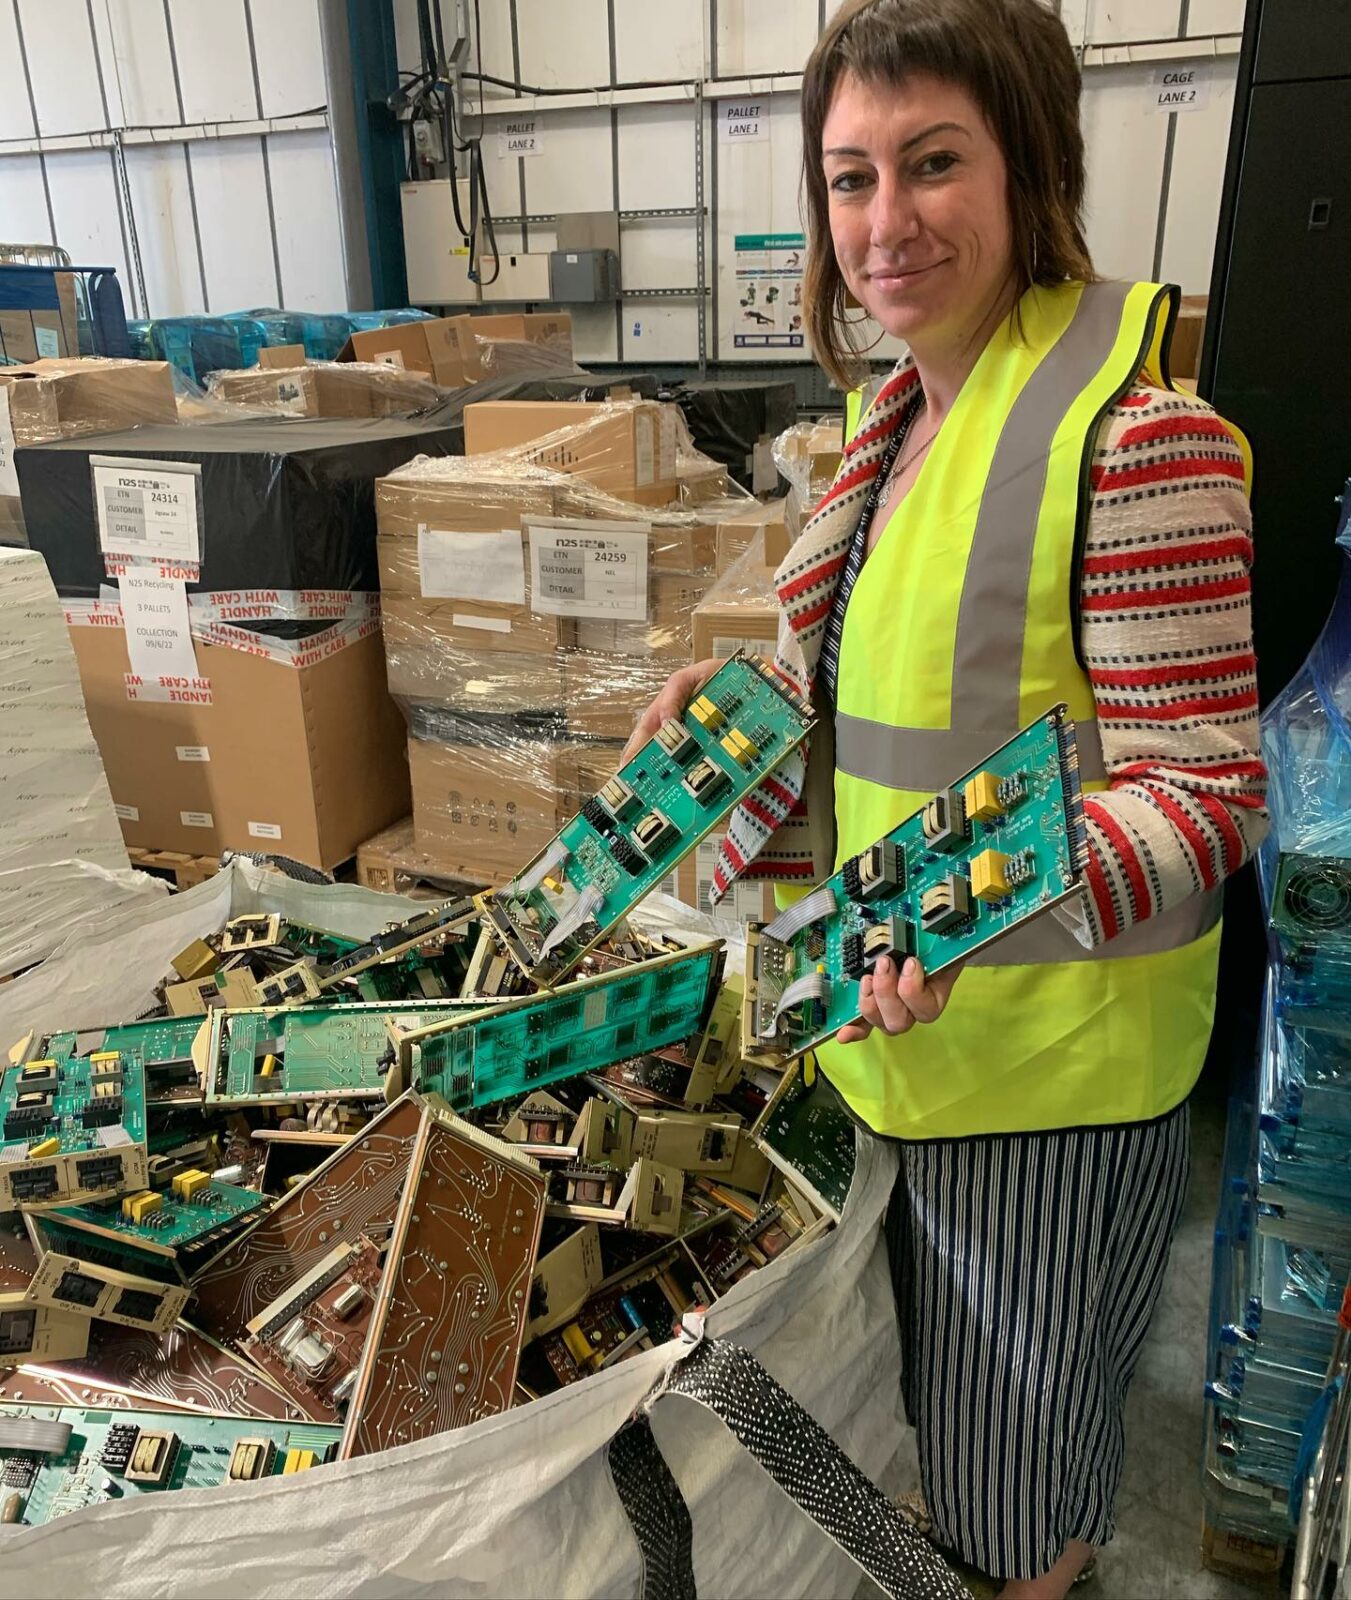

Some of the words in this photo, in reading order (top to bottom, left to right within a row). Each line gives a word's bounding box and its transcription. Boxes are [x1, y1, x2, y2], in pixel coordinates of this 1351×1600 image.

[1163, 71, 1195, 84] CAGE
[1158, 91, 1187, 103] LANE
[1189, 90, 1196, 101] 2
[727, 106, 760, 118] PALLET
[506, 123, 535, 133] PALLET
[728, 124, 751, 134] LANE
[508, 139, 528, 149] LANE
[529, 139, 535, 148] 2
[117, 490, 130, 498] ETN
[151, 492, 178, 503] 24314
[107, 505, 143, 514] CUSTOMER
[115, 524, 138, 533] DETAIL
[553, 551, 568, 559] ETN
[594, 552, 626, 562] 24259
[541, 565, 582, 574] CUSTOMER
[144, 580, 175, 591] Recycling
[549, 585, 574, 593] DETAIL
[209, 593, 241, 606] CARE
[246, 592, 280, 603] WITH
[300, 592, 326, 604] CARE
[330, 592, 353, 603] WITH
[137, 603, 142, 612] 3
[144, 604, 171, 613] PALLETS
[220, 606, 272, 619] HANDLE
[308, 606, 346, 617] HANDLE
[87, 614, 119, 625] WITH
[136, 627, 178, 637] COLLECTION
[210, 622, 261, 645] HANDLE
[145, 639, 173, 649] 09/6/22
[299, 626, 339, 651] HANDLE
[291, 649, 321, 667] WITH
[324, 635, 347, 655] CARE
[159, 676, 189, 688] CARE
